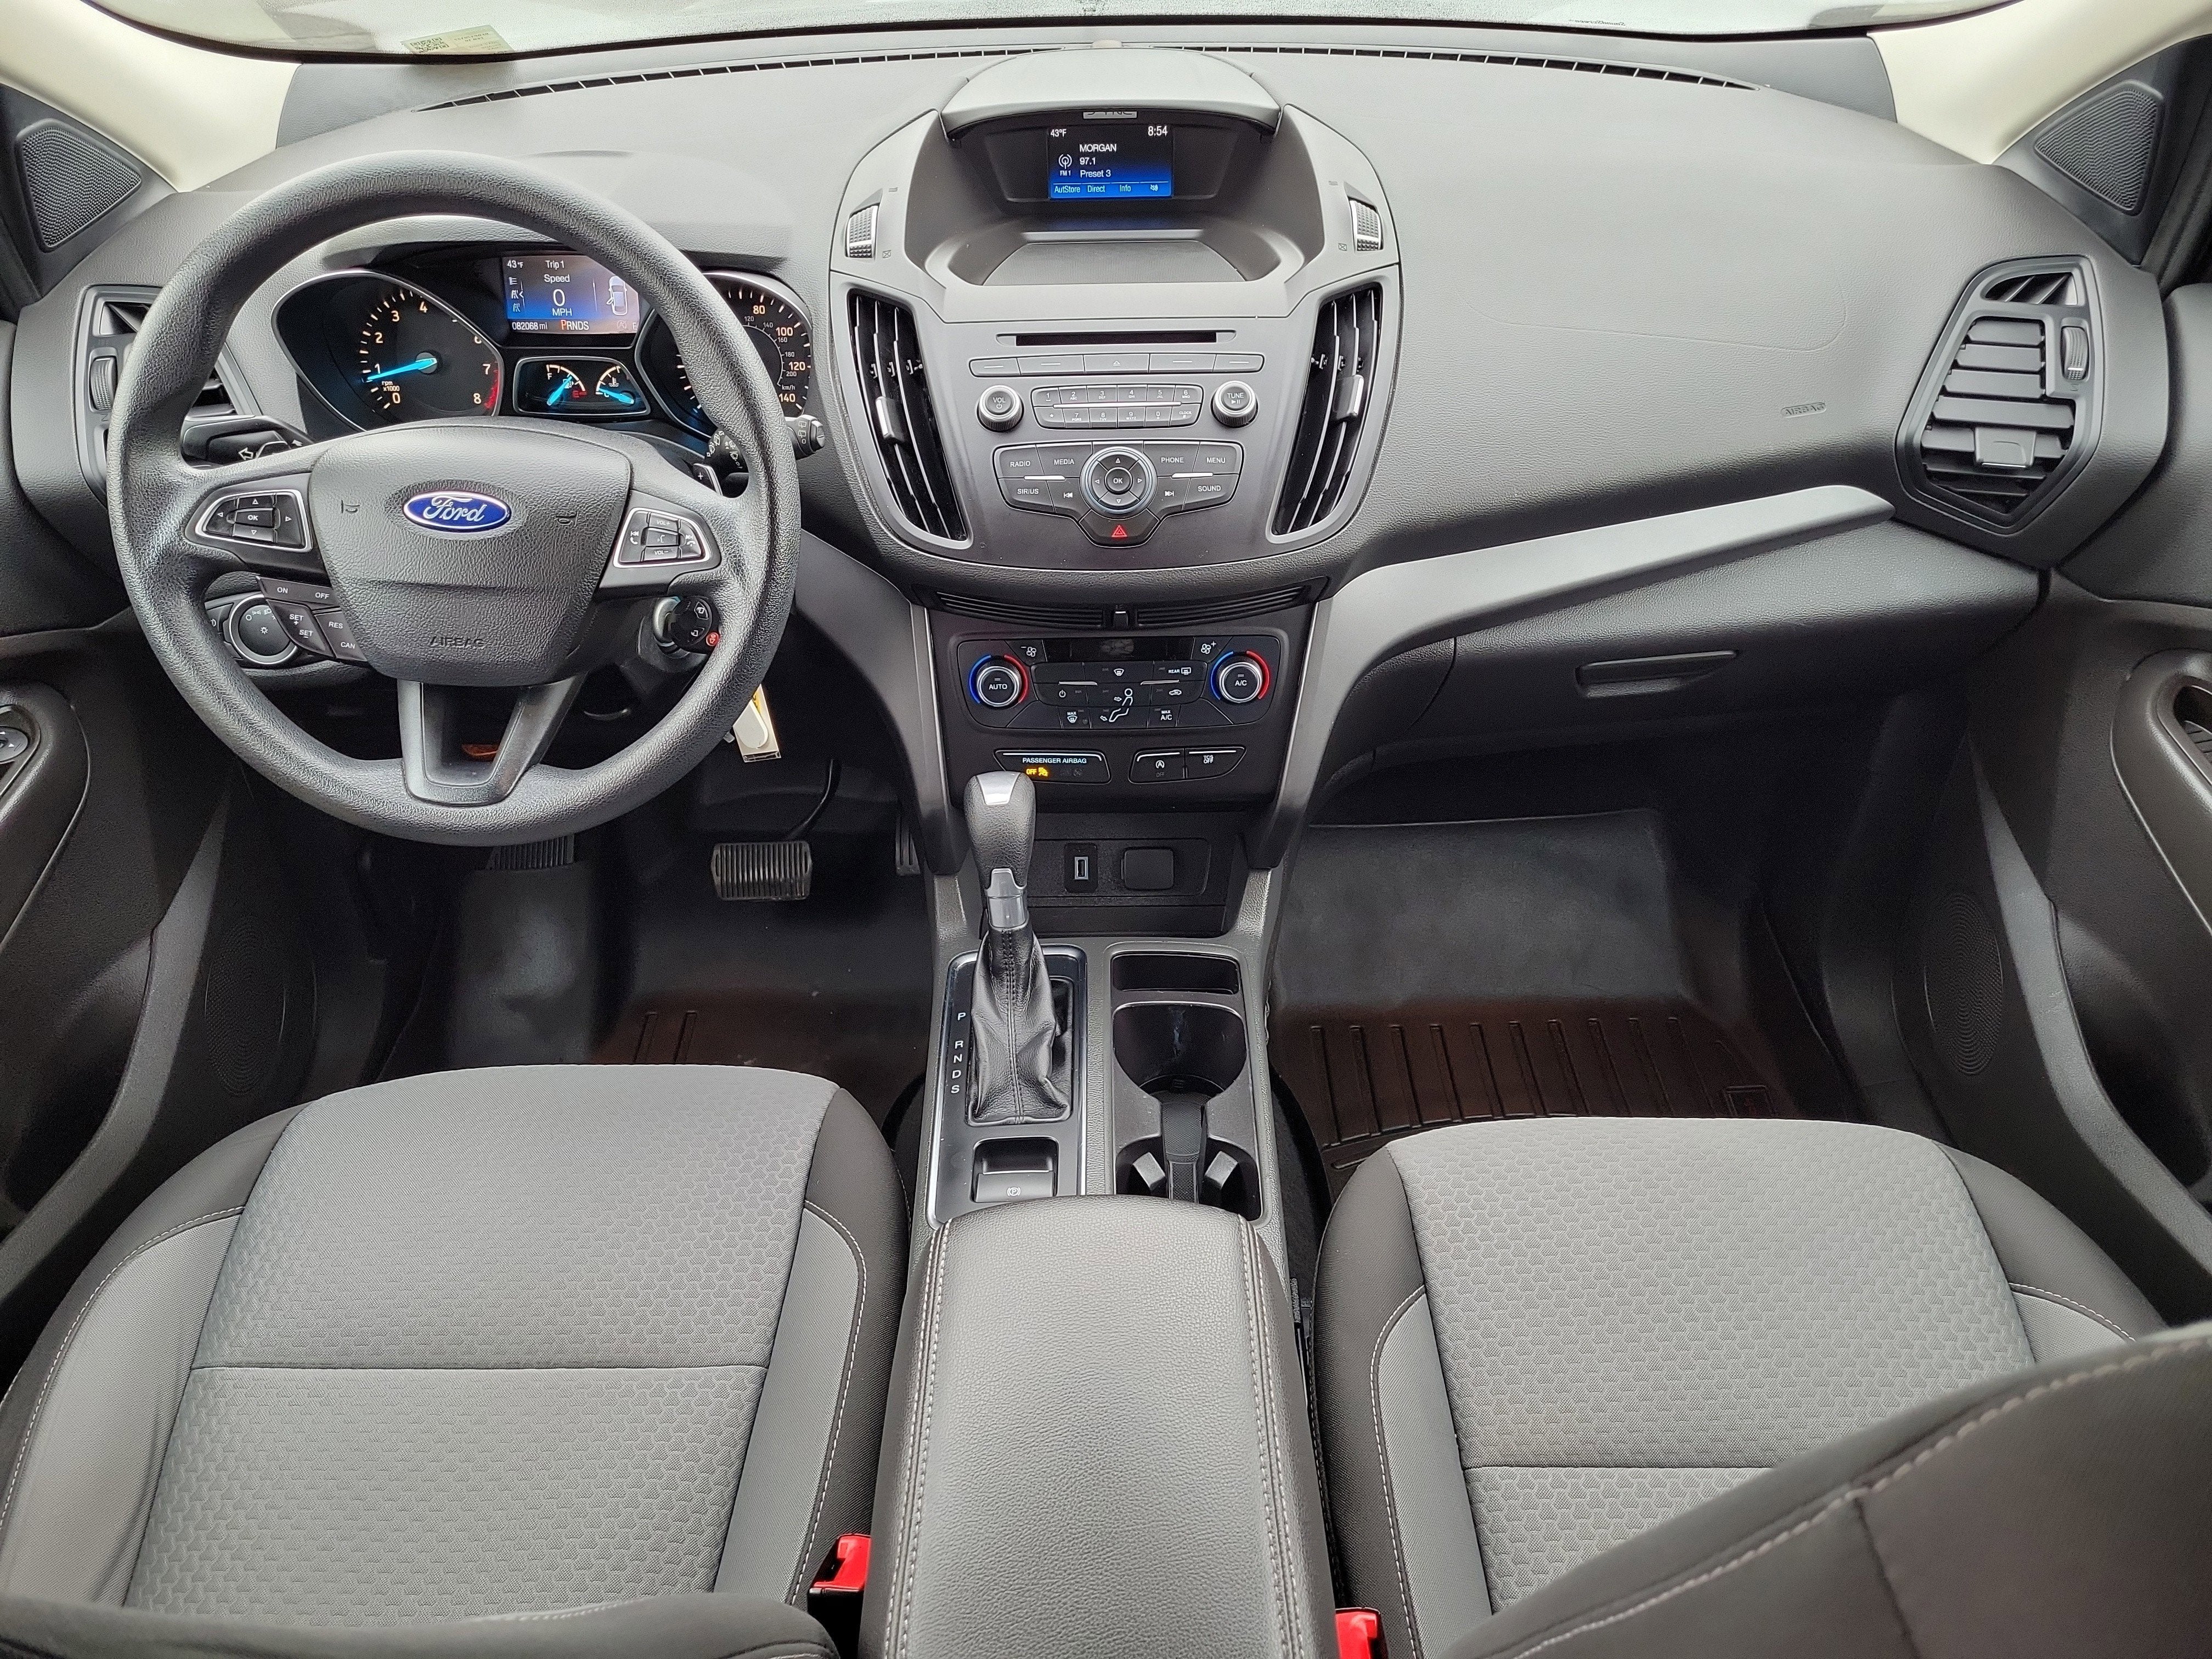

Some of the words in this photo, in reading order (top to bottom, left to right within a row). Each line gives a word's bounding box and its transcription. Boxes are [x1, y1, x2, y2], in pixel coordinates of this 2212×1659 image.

[1050, 128, 1067, 137] 43°F
[1148, 126, 1168, 137] 8:54
[1079, 143, 1117, 153] MORGAN
[1079, 157, 1096, 165] 97.1
[1080, 170, 1104, 178] Preset
[1054, 184, 1081, 193] AutStore
[1087, 184, 1105, 193] Direct
[545, 260, 560, 269] Trip
[544, 274, 571, 283] Speed
[553, 289, 566, 307] 0
[419, 302, 428, 313] 4
[753, 305, 766, 314] 80
[392, 312, 400, 322] 3
[552, 308, 572, 317] MPH
[512, 321, 539, 330] 082068
[776, 327, 793, 336] 100
[375, 332, 383, 344] 2
[375, 363, 381, 374] 1
[483, 364, 491, 375] 7
[788, 362, 806, 371] 120
[392, 392, 401, 404] 0
[473, 393, 482, 404] 8
[779, 393, 795, 402] 140
[1785, 404, 1825, 415] AIRBAG
[1053, 458, 1075, 466] MEDIA
[1197, 484, 1222, 493] SOUND
[423, 495, 488, 522] Ford
[957, 1012, 967, 1021] P
[955, 1040, 964, 1049] R
[953, 1054, 963, 1063] N
[952, 1070, 962, 1079] D
[951, 1085, 960, 1094] S
